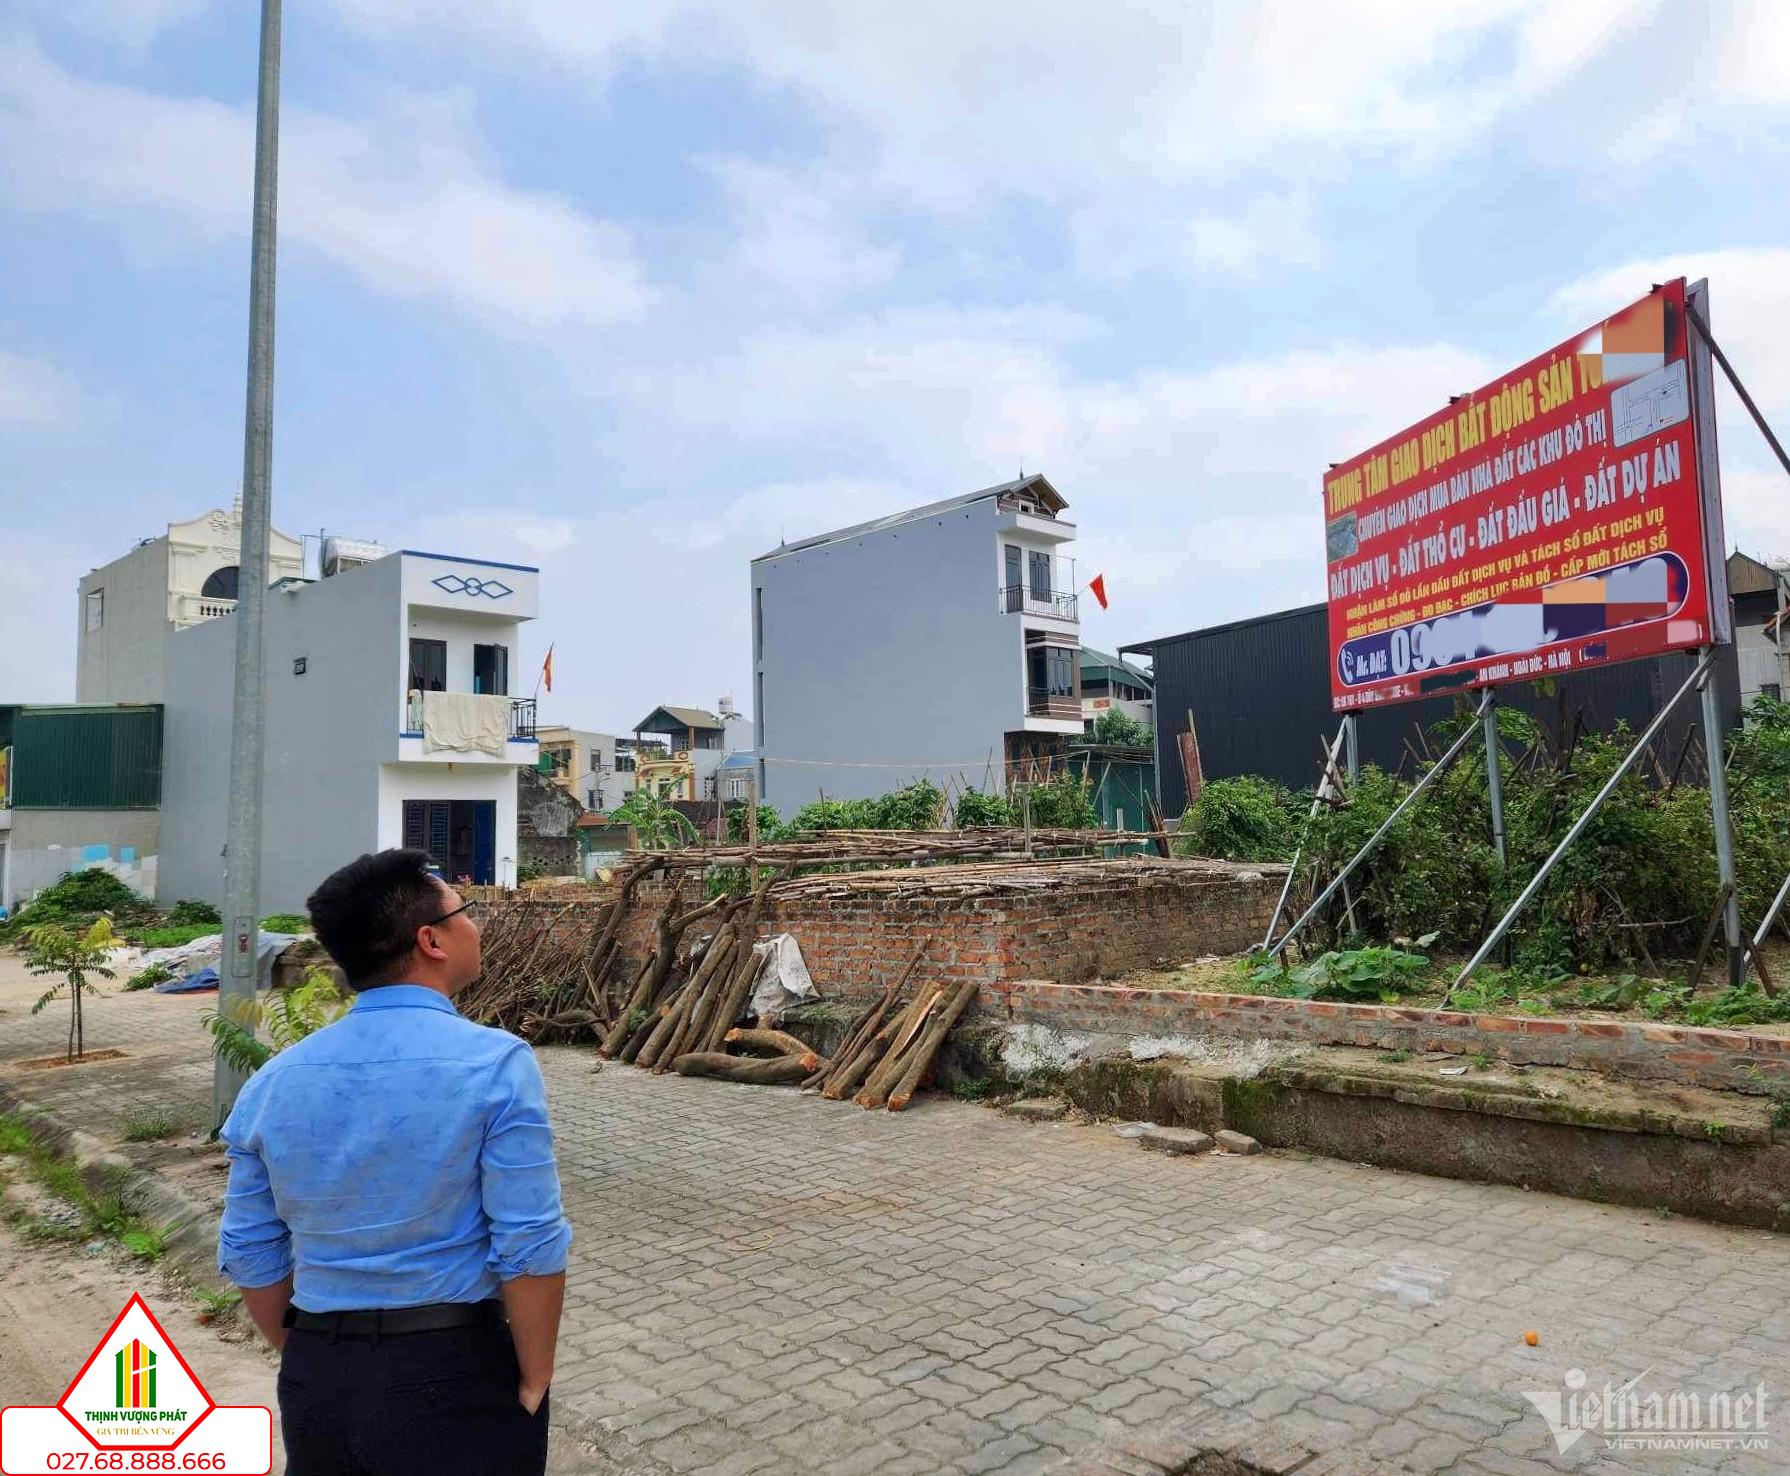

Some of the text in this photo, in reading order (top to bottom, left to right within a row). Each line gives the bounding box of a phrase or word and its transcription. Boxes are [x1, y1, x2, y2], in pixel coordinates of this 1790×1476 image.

[1327, 468, 1362, 515] TRUNG
[1364, 453, 1389, 497] TÂM
[1391, 438, 1420, 486] GIAO
[1421, 418, 1456, 473] DỊCH
[1458, 395, 1486, 453] BẤT
[1489, 377, 1535, 439] ĐỘNG
[1537, 353, 1573, 414] SẢN
[1357, 408, 1607, 542] CHUYÊN GIAO DỊCH MUA BÁN NHÀ ĐẤT CÁC KHU ĐÔ THỊ
[1331, 562, 1348, 601] ĐẤT
[1350, 560, 1374, 600] DỊCH
[1375, 553, 1390, 591] VỤ
[1399, 534, 1420, 577] ĐẤT
[1422, 520, 1447, 569] THỔ
[1477, 501, 1504, 550] ĐẤT
[1506, 488, 1538, 540] ĐẤU
[1541, 476, 1571, 527] GIÁ
[1584, 455, 1617, 512] ĐẤT
[1621, 452, 1649, 504] DỰ
[1653, 438, 1681, 488] ÁN
[1367, 617, 1388, 633] CÔNG
[1389, 608, 1416, 627] CHỨNG
[1422, 604, 1434, 618] ĐO
[1435, 598, 1453, 615] ĐẠC
[1460, 586, 1489, 607] CHÍCH
[1561, 555, 1585, 578] CẤP
[1587, 548, 1611, 571] MỚI
[1613, 539, 1647, 563] TÁCH
[1649, 526, 1668, 552] SỔ
[1368, 599, 1386, 614] LÀM
[1451, 568, 1470, 588] ĐẤT
[1471, 562, 1496, 583] DỊCH
[1497, 557, 1512, 574] VỤ
[1513, 549, 1529, 568] VÀ
[1530, 542, 1561, 563] TÁCH
[1583, 522, 1608, 547] ĐẤT
[1610, 514, 1643, 538] DỊCH
[1645, 506, 1665, 526] VỤ
[1479, 668, 1488, 682] AN
[1488, 661, 1509, 681] KHÁNH
[1529, 654, 1543, 673] ĐỨC
[1547, 650, 1559, 670] HÀ
[1558, 648, 1571, 670] NỘI
